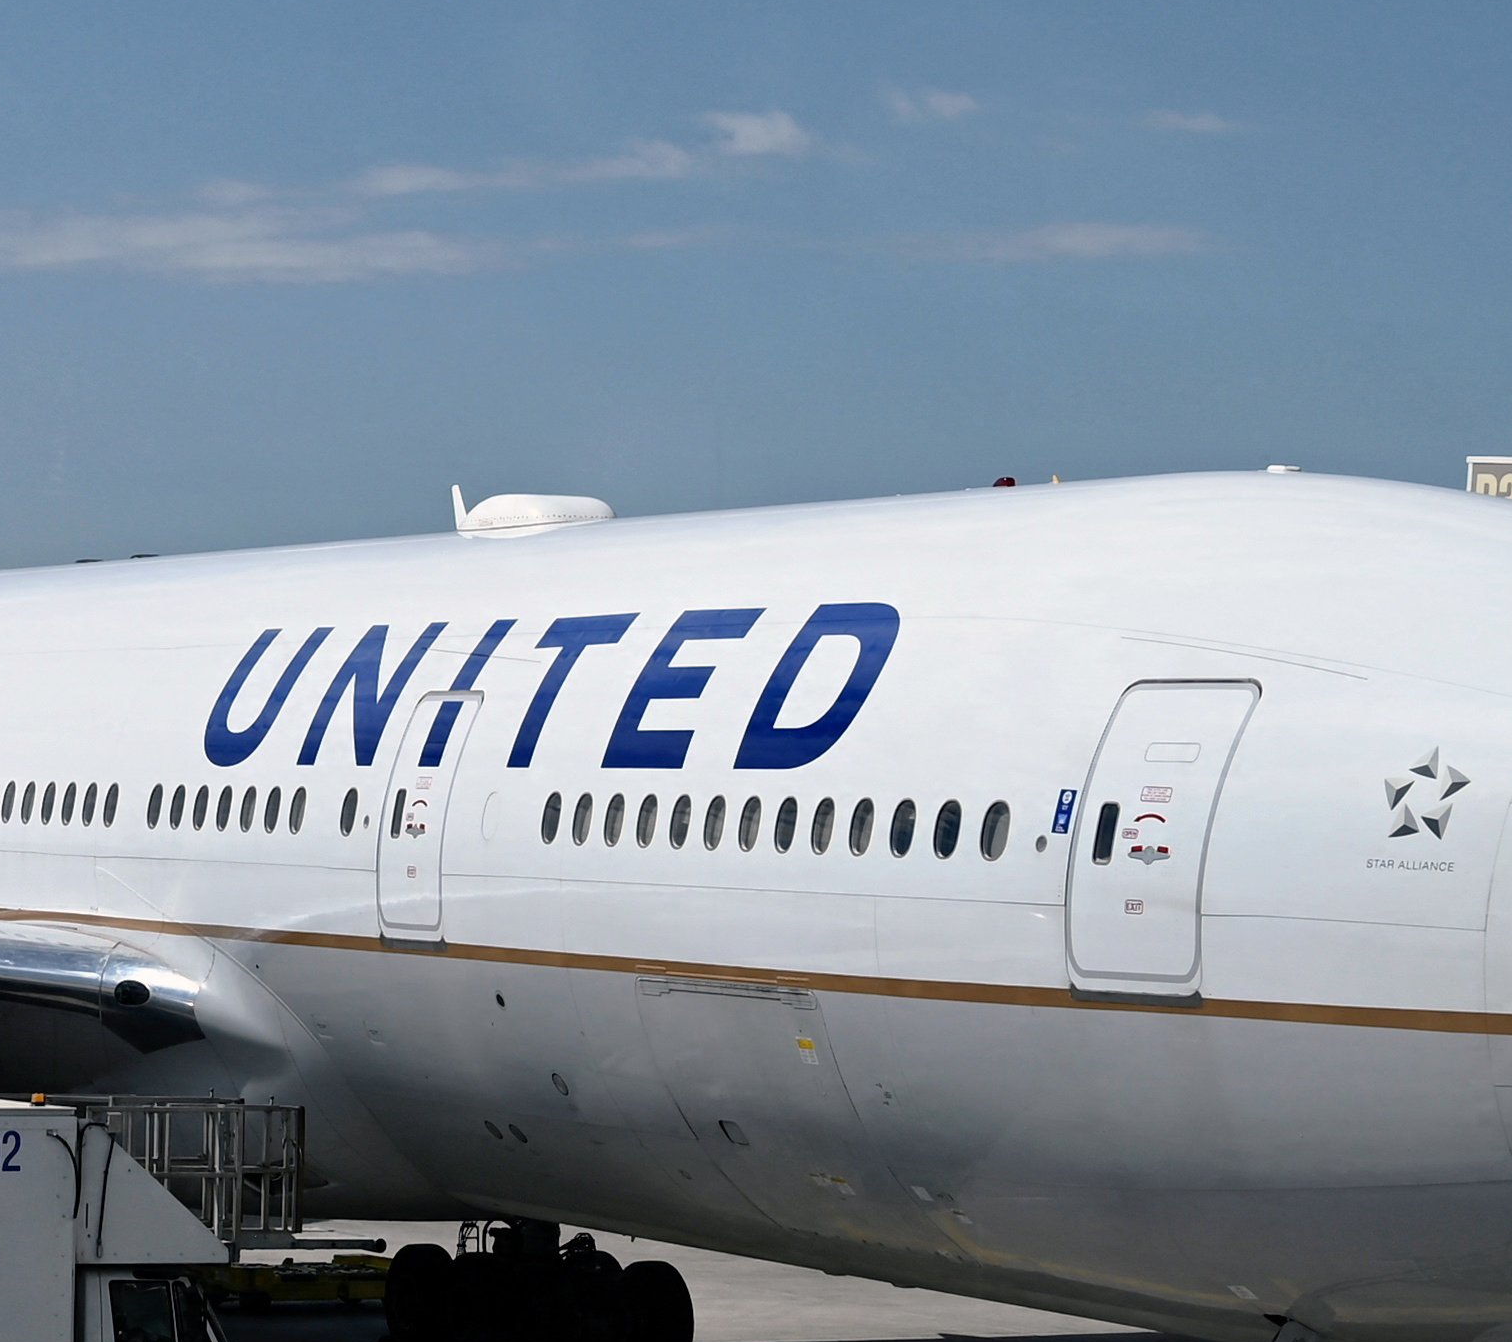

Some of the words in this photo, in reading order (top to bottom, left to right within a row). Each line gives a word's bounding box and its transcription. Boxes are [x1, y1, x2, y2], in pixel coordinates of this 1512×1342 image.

[203, 601, 901, 769] UNITED
[1366, 858, 1395, 869] STAR
[1397, 860, 1455, 872] ALLIANCE
